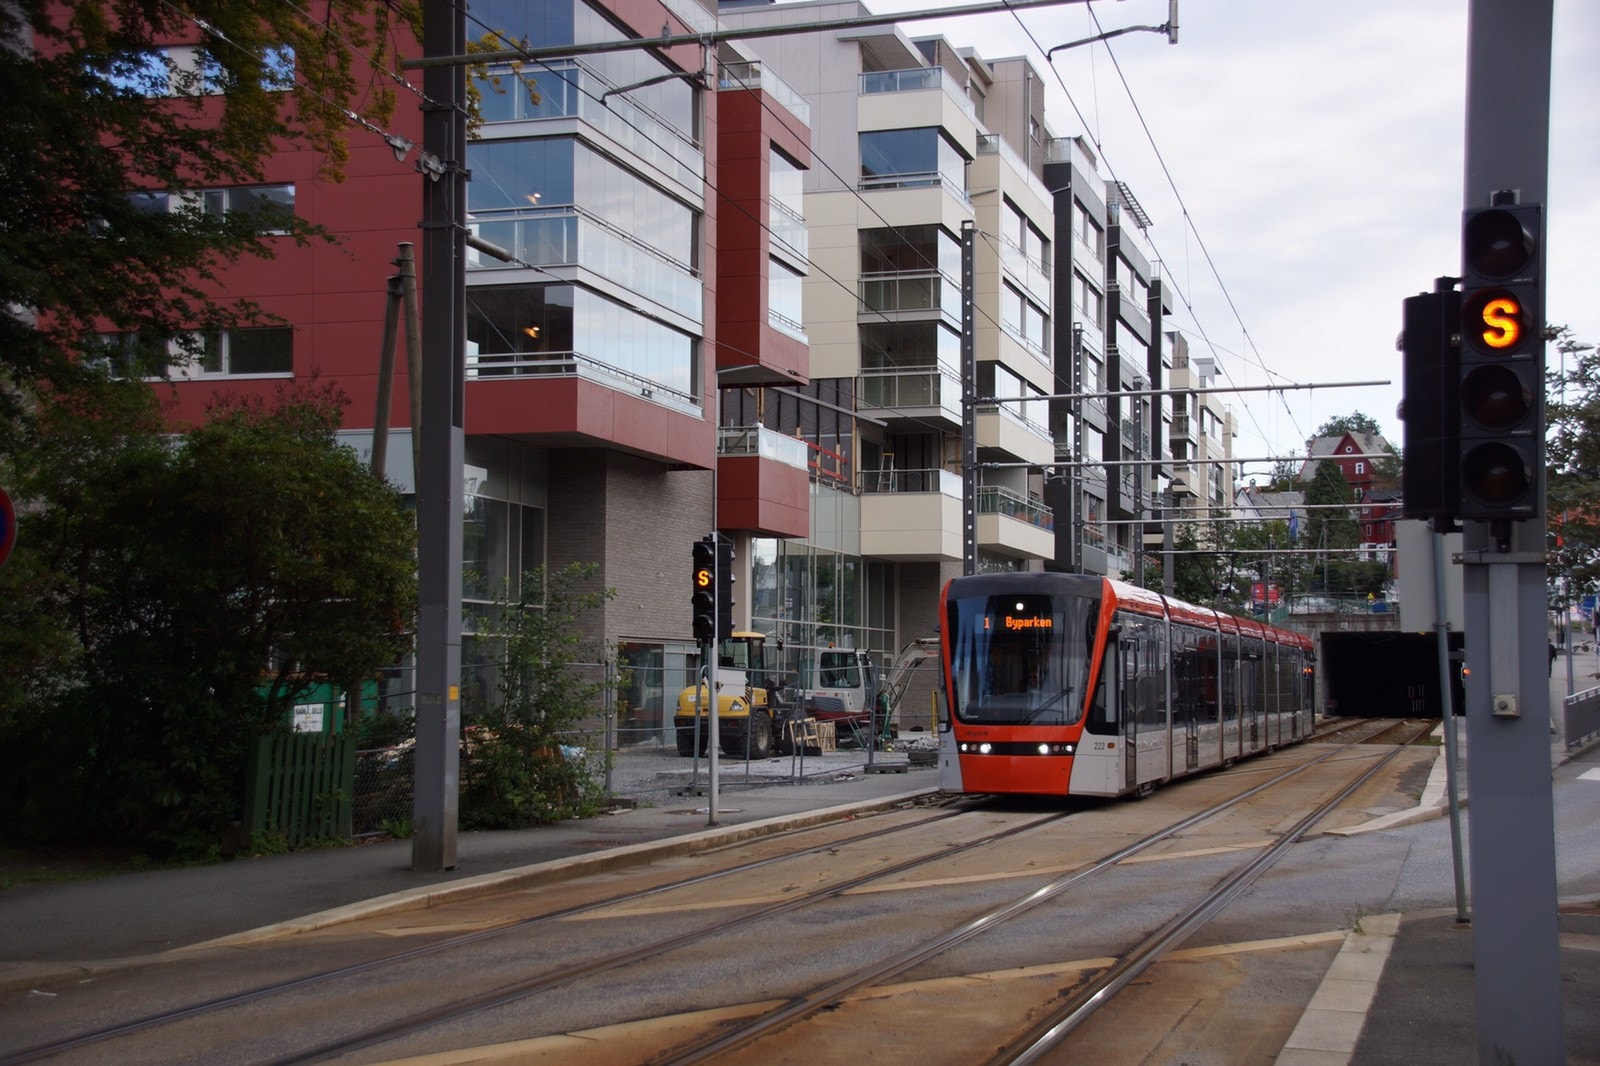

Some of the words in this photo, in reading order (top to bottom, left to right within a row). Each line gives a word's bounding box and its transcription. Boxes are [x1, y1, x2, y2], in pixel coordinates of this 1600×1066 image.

[1483, 299, 1518, 348] S
[699, 570, 709, 586] S
[984, 617, 990, 629] 1
[1005, 615, 1052, 630] Byparken
[1094, 741, 1105, 750] 222
